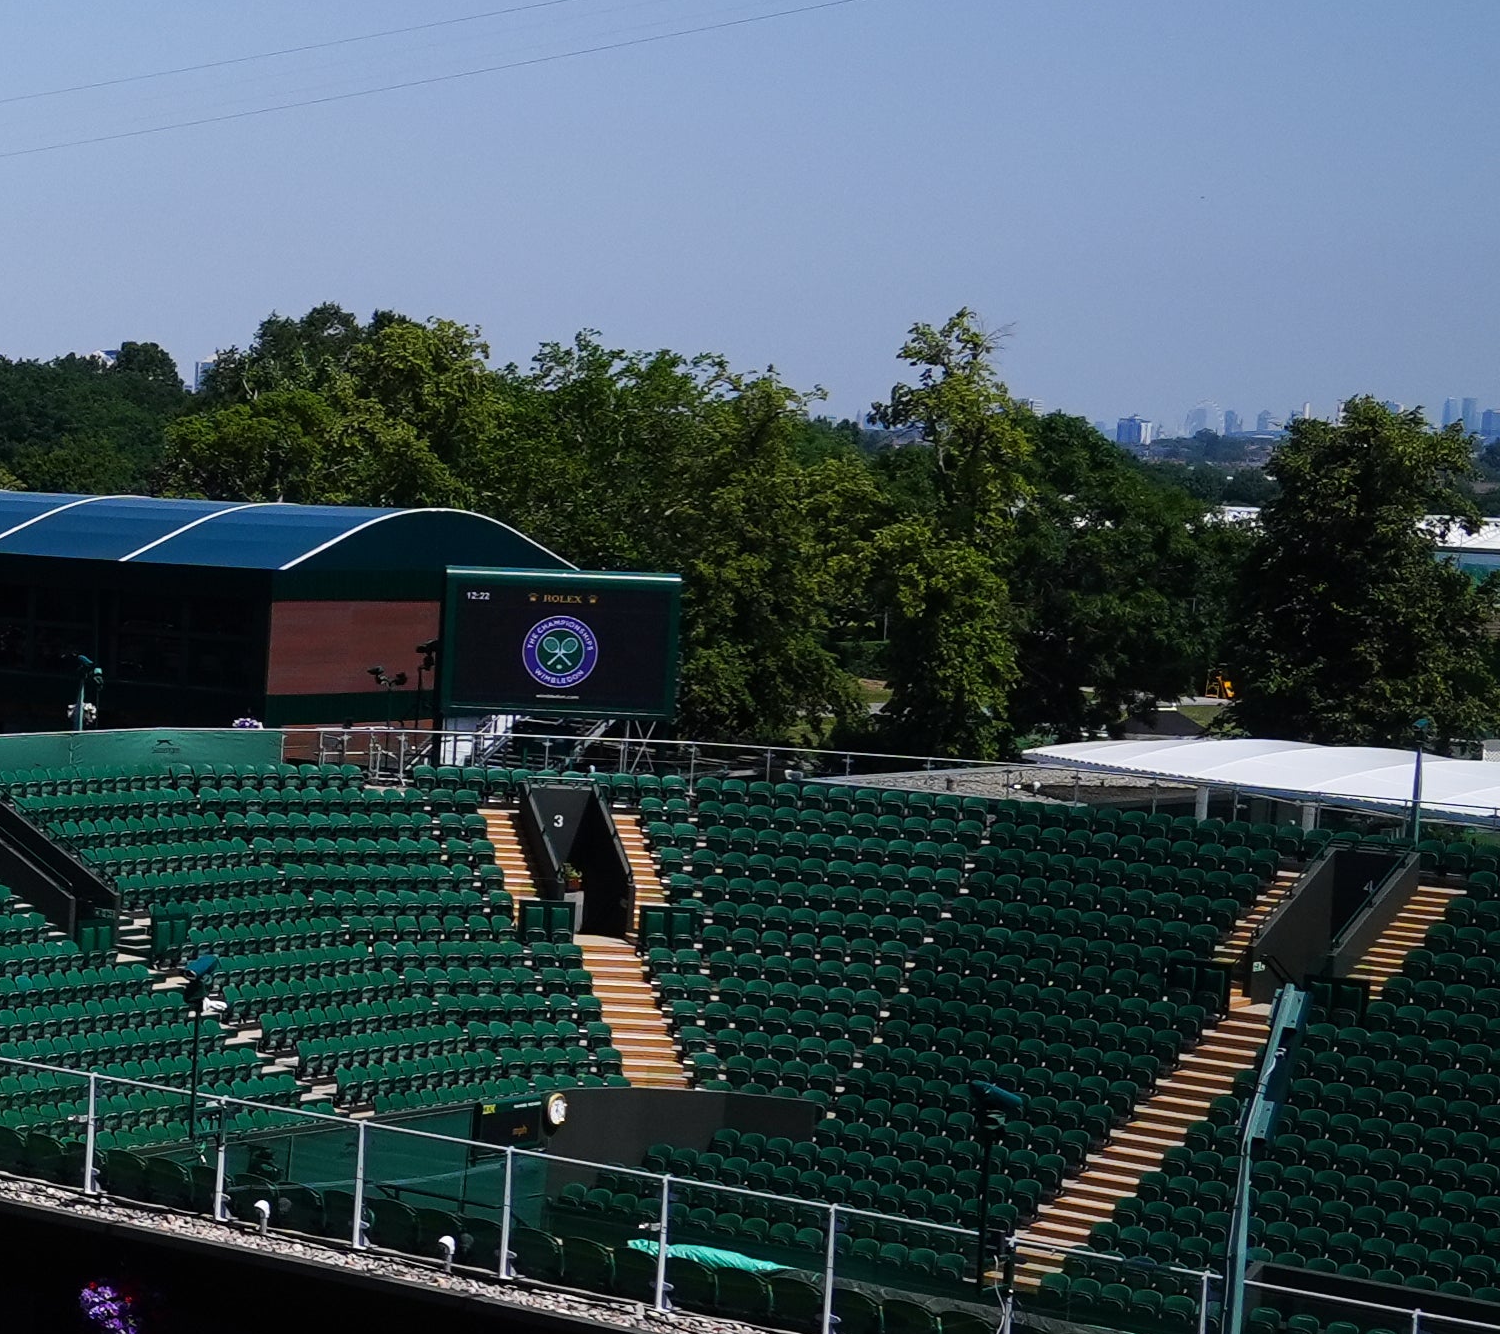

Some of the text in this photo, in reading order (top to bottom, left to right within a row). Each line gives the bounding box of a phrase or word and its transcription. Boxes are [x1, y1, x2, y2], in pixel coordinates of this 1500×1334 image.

[466, 591, 582, 604] 12:22 ROLEX
[526, 619, 593, 651] THE CHAMPIONSHIPS
[534, 669, 584, 685] WIMBLEDON
[553, 814, 564, 828] 3
